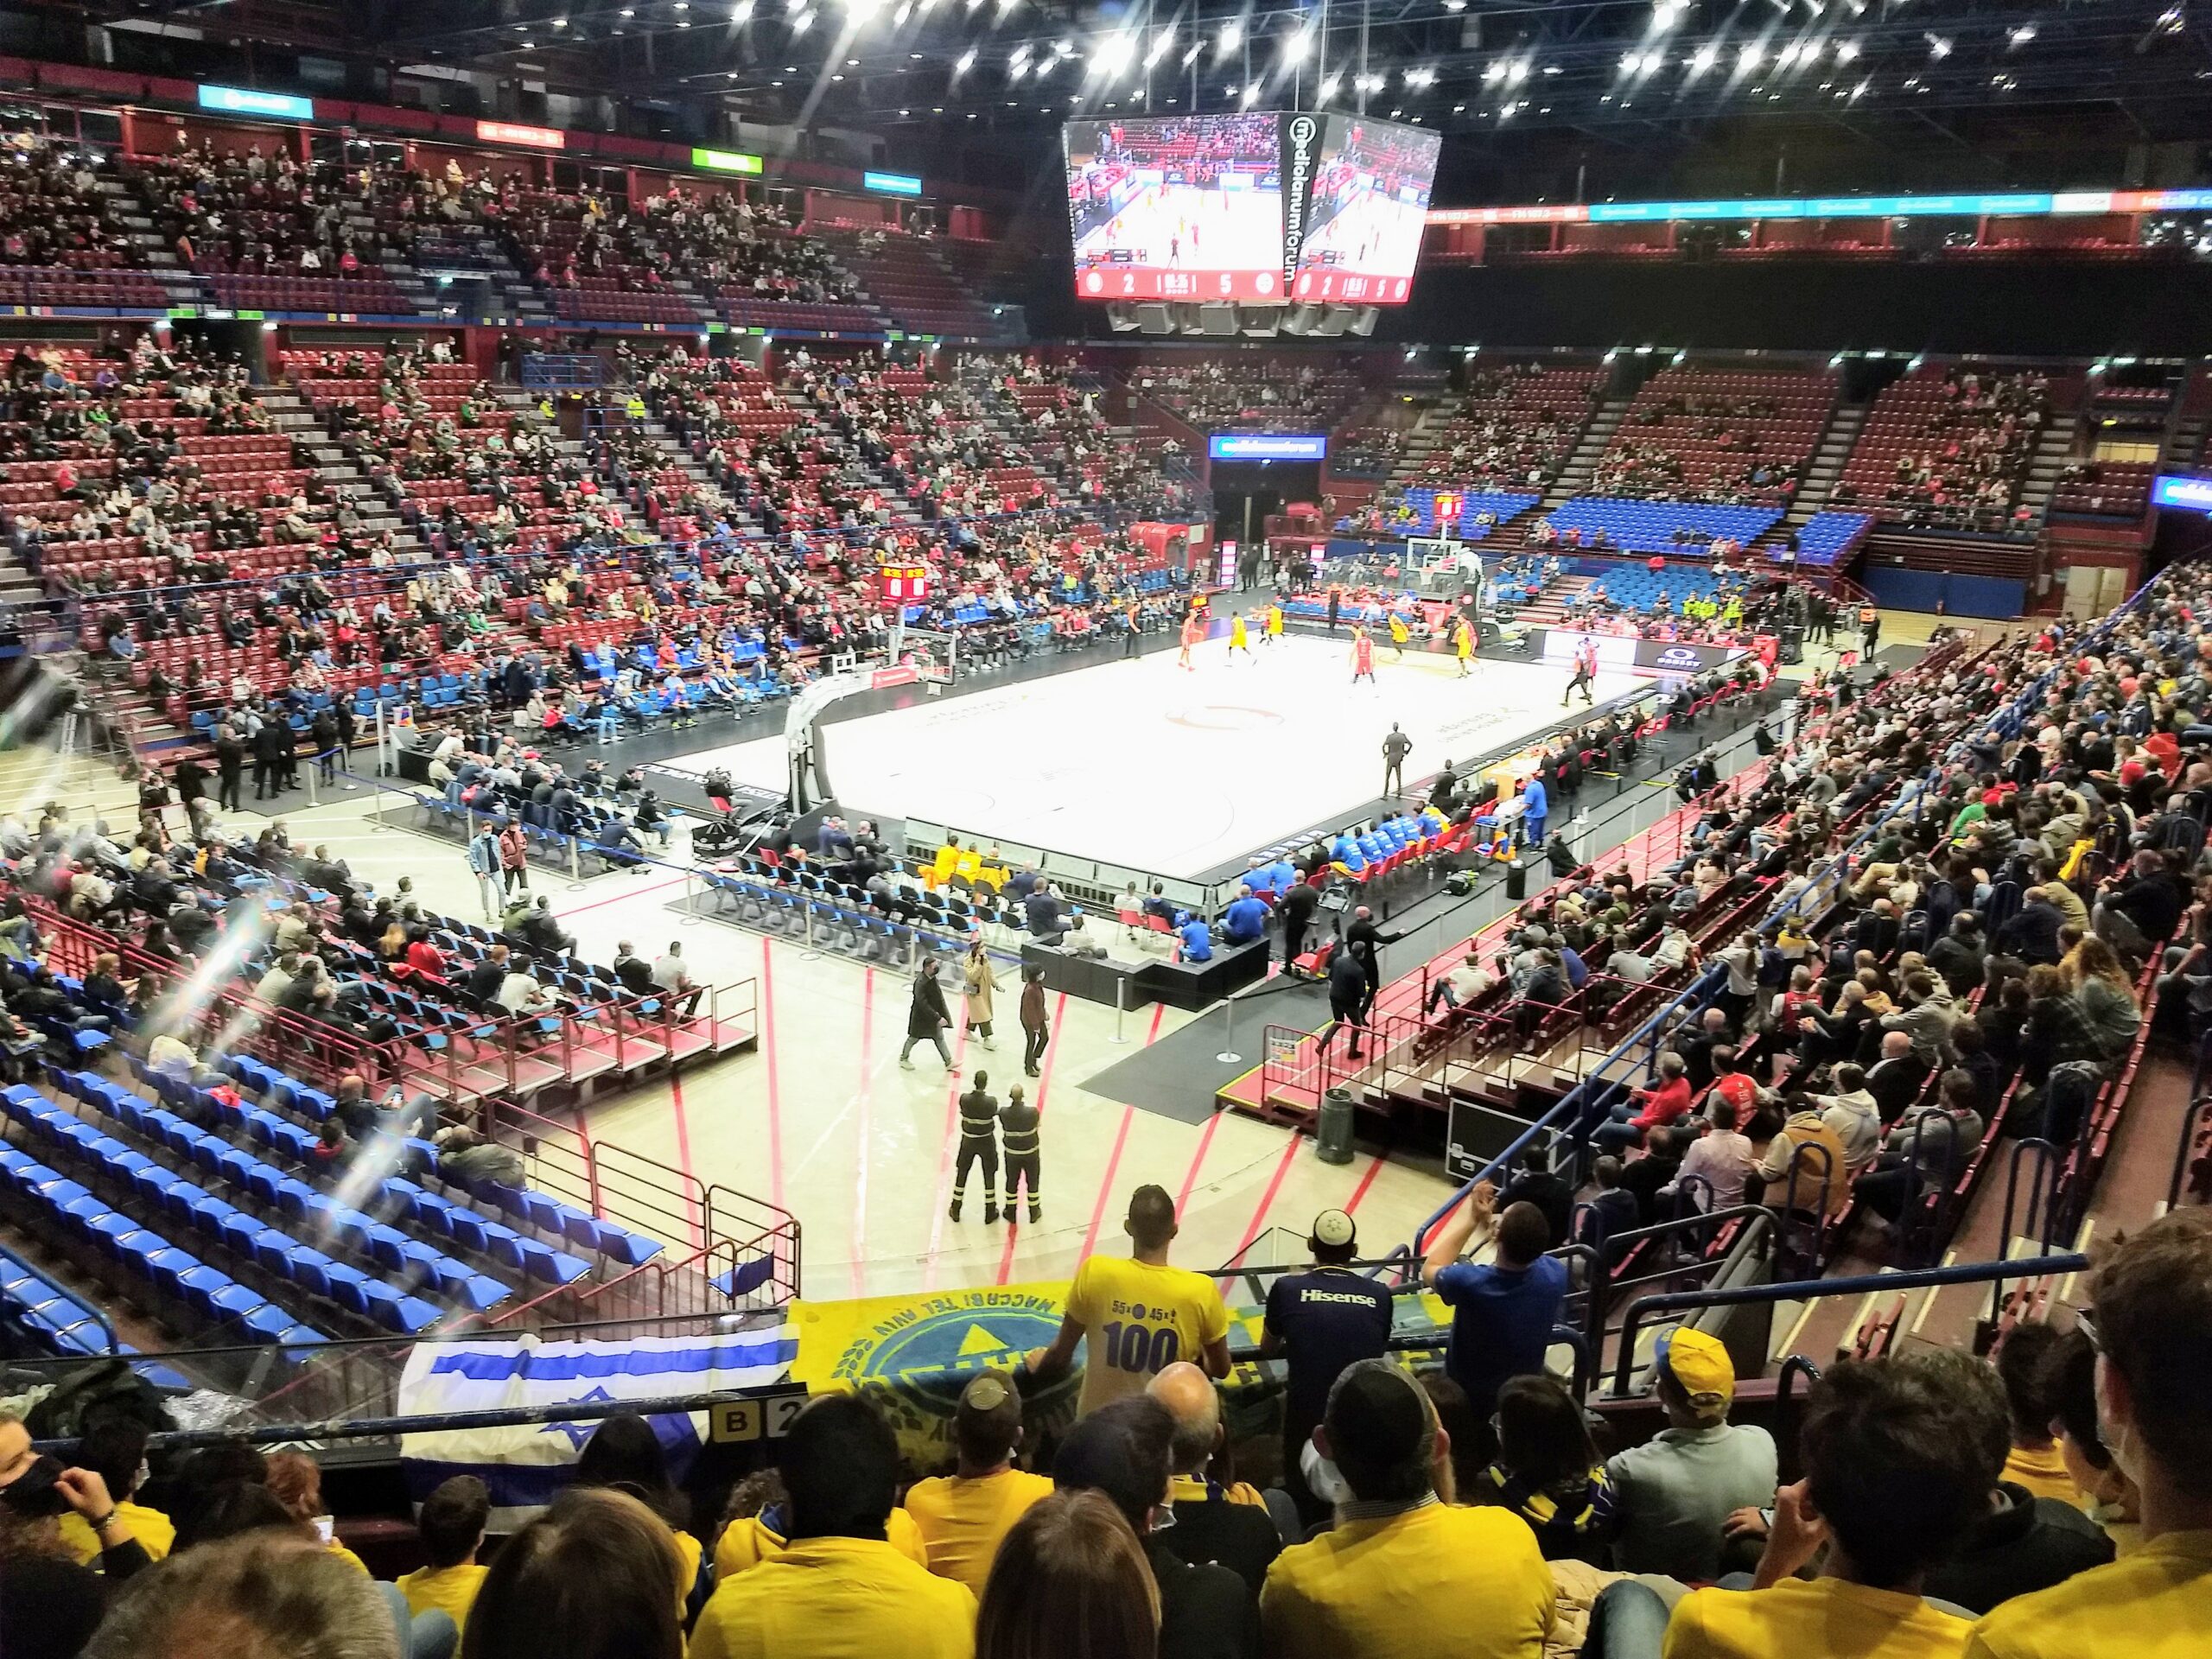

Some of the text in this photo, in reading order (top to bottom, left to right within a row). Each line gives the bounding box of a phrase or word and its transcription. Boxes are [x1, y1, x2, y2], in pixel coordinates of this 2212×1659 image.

[1283, 117, 1317, 282] mediolanumforum
[1123, 274, 1135, 293] 2
[1220, 274, 1231, 294] 5
[1321, 276, 1332, 296] 2
[1376, 279, 1386, 297] 5
[1300, 1288, 1376, 1308] Hisense
[873, 1293, 1056, 1337] MACCABI TEL AVIV
[1103, 1320, 1179, 1376] 100
[726, 1410, 748, 1433] B
